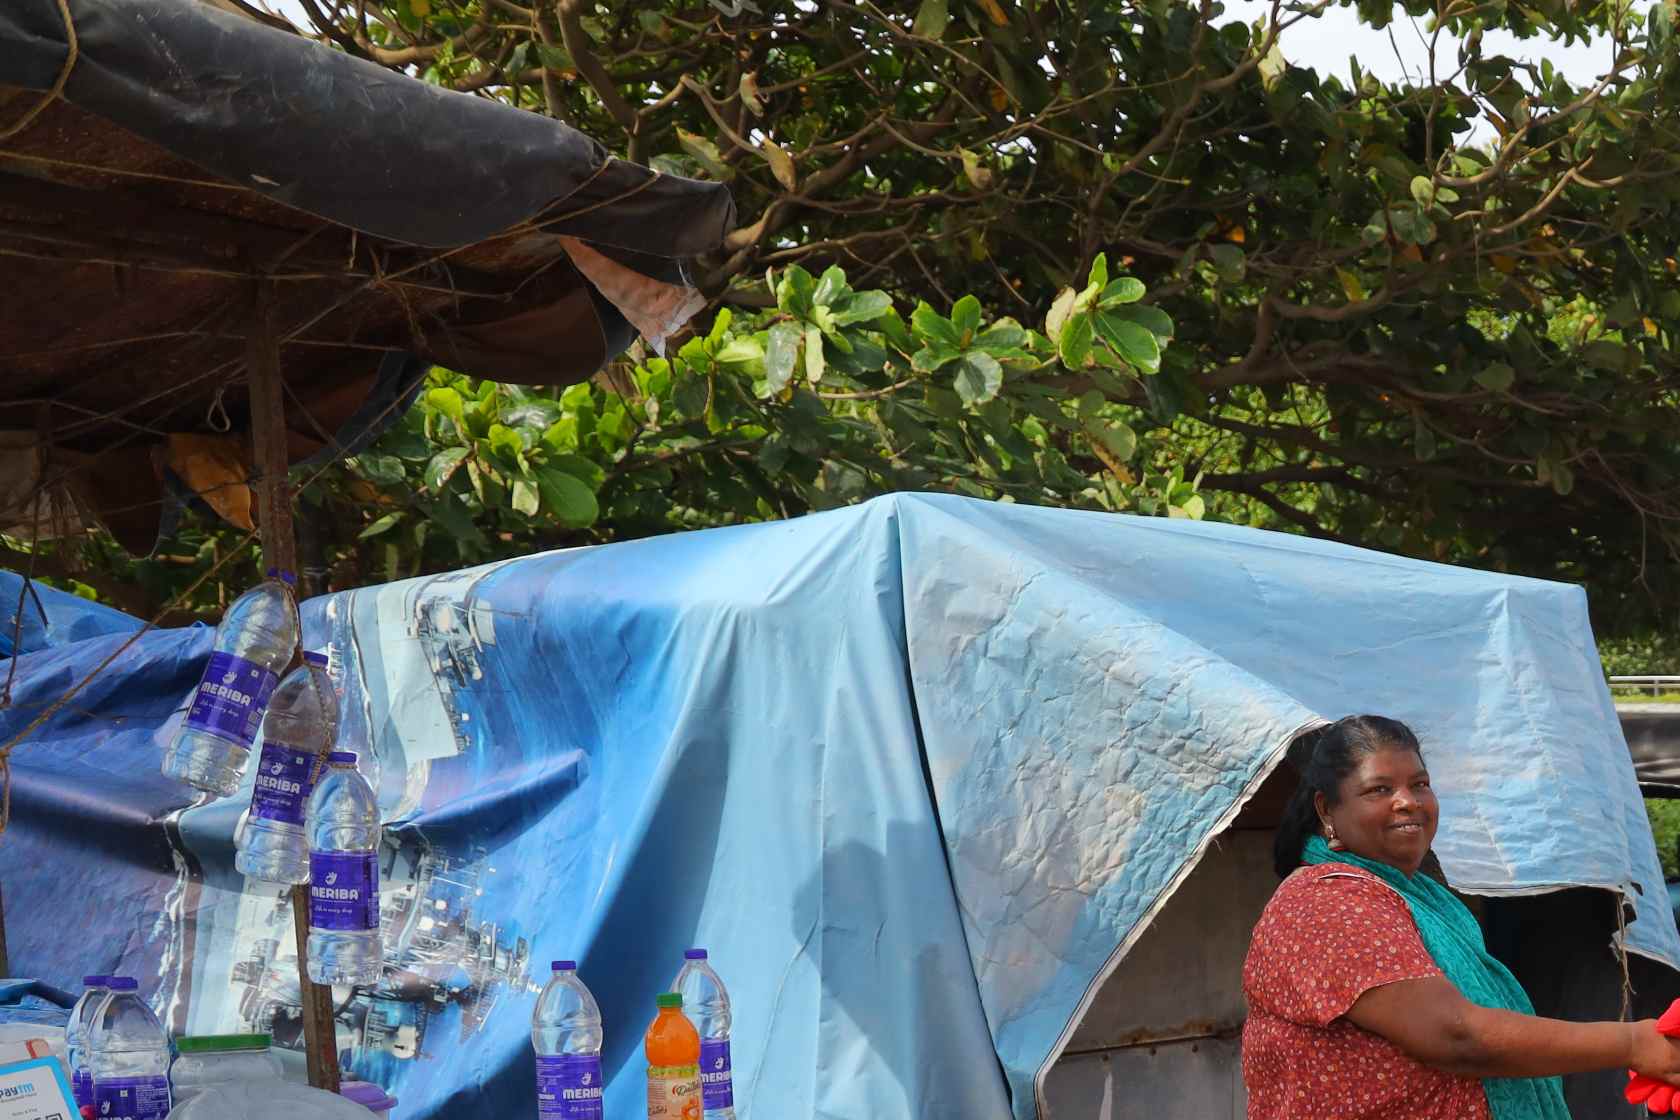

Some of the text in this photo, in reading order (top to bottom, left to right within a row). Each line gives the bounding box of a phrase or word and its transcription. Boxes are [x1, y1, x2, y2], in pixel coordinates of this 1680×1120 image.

[201, 681, 252, 706] MERIBA
[257, 774, 301, 795] MERIBA
[311, 886, 359, 901] MERIBA
[699, 1071, 731, 1083] MERIB
[562, 1087, 603, 1100] MERIB
